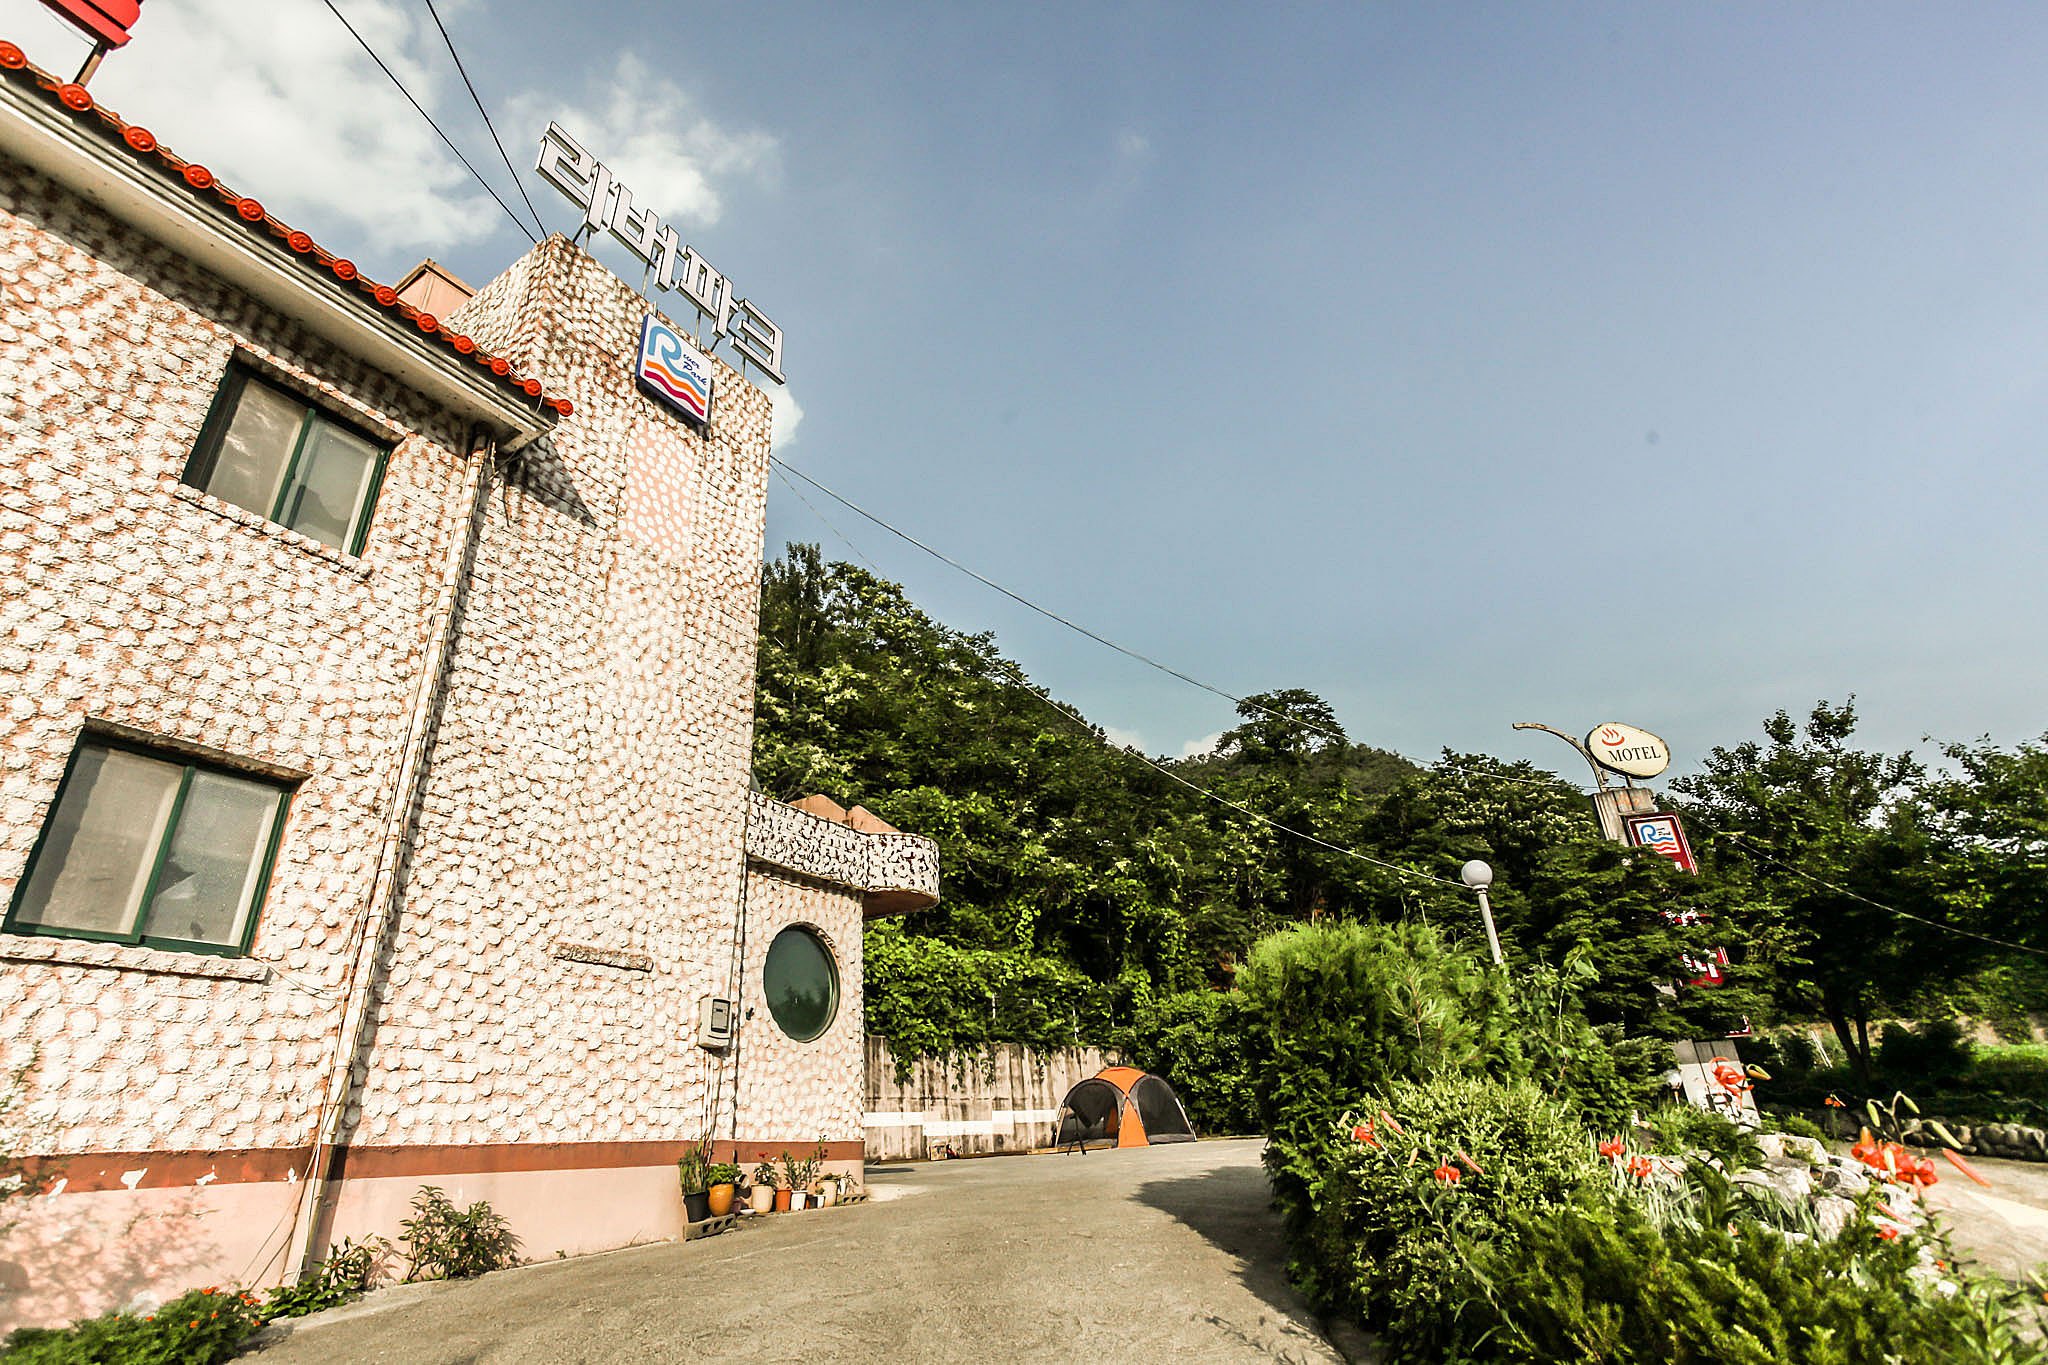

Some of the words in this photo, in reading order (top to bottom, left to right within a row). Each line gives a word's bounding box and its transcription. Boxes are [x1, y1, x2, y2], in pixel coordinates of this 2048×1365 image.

[534, 120, 787, 385] 리버파크
[682, 361, 708, 386] Park
[1607, 744, 1662, 763] MOTEL
